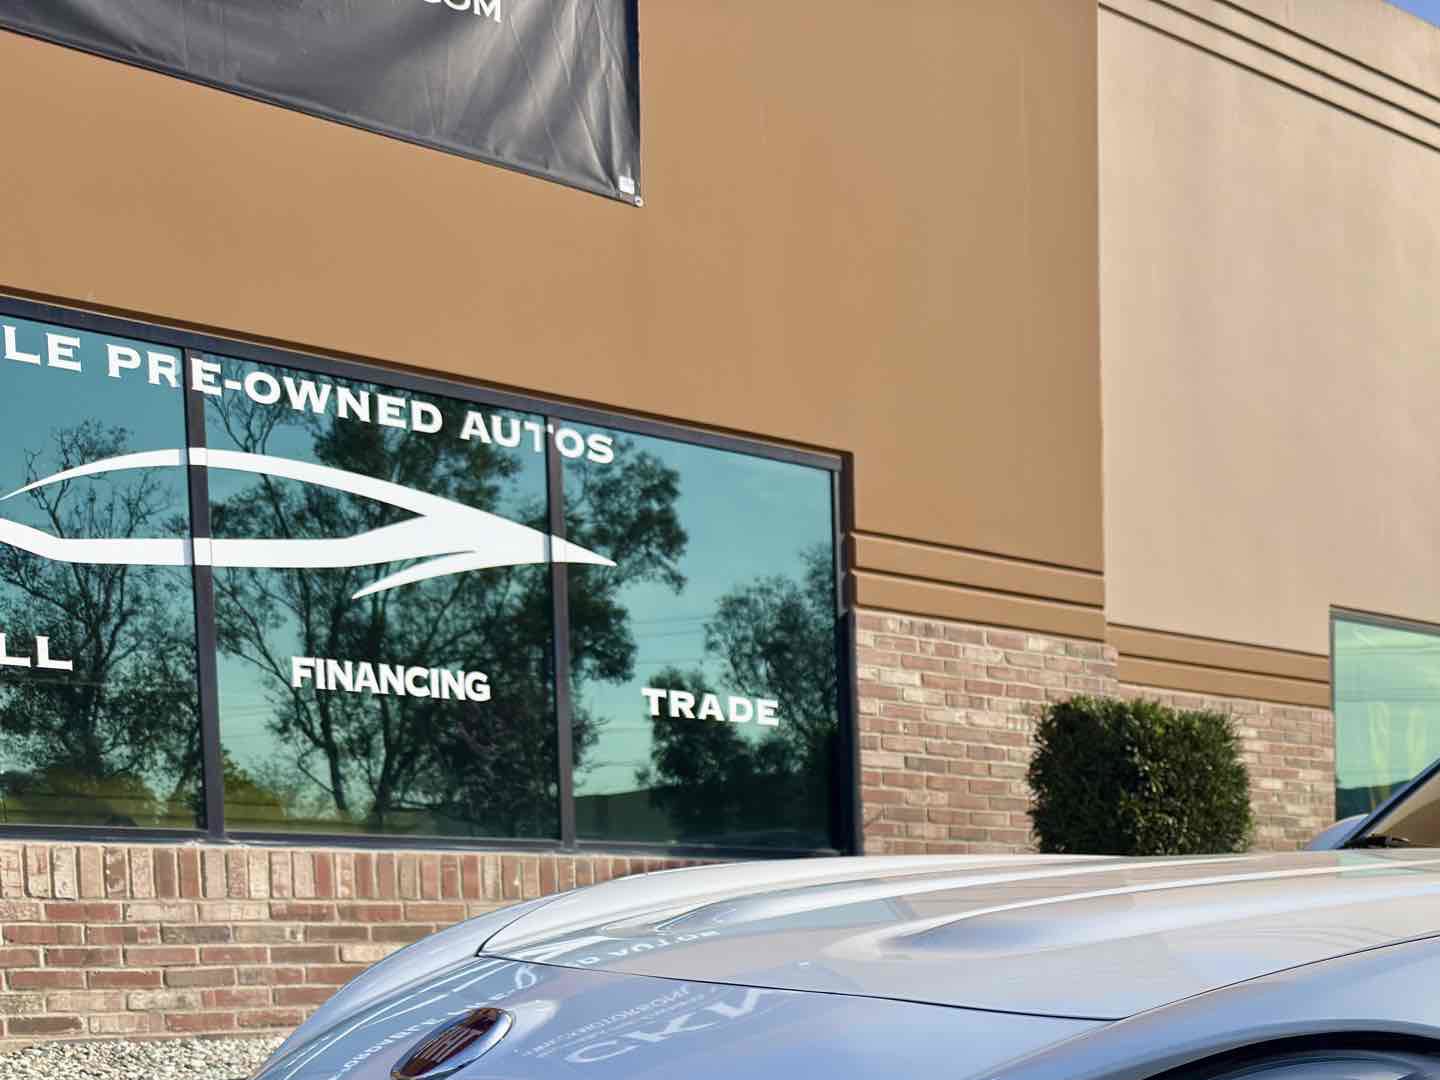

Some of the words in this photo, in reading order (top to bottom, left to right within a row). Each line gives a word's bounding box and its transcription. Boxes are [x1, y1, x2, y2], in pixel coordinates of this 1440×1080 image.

[2, 325, 82, 373] LE
[106, 343, 443, 434] PRE-OWNED
[460, 411, 615, 464] AUTOS
[291, 656, 491, 702] FINANCING
[641, 686, 780, 727] TRADE
